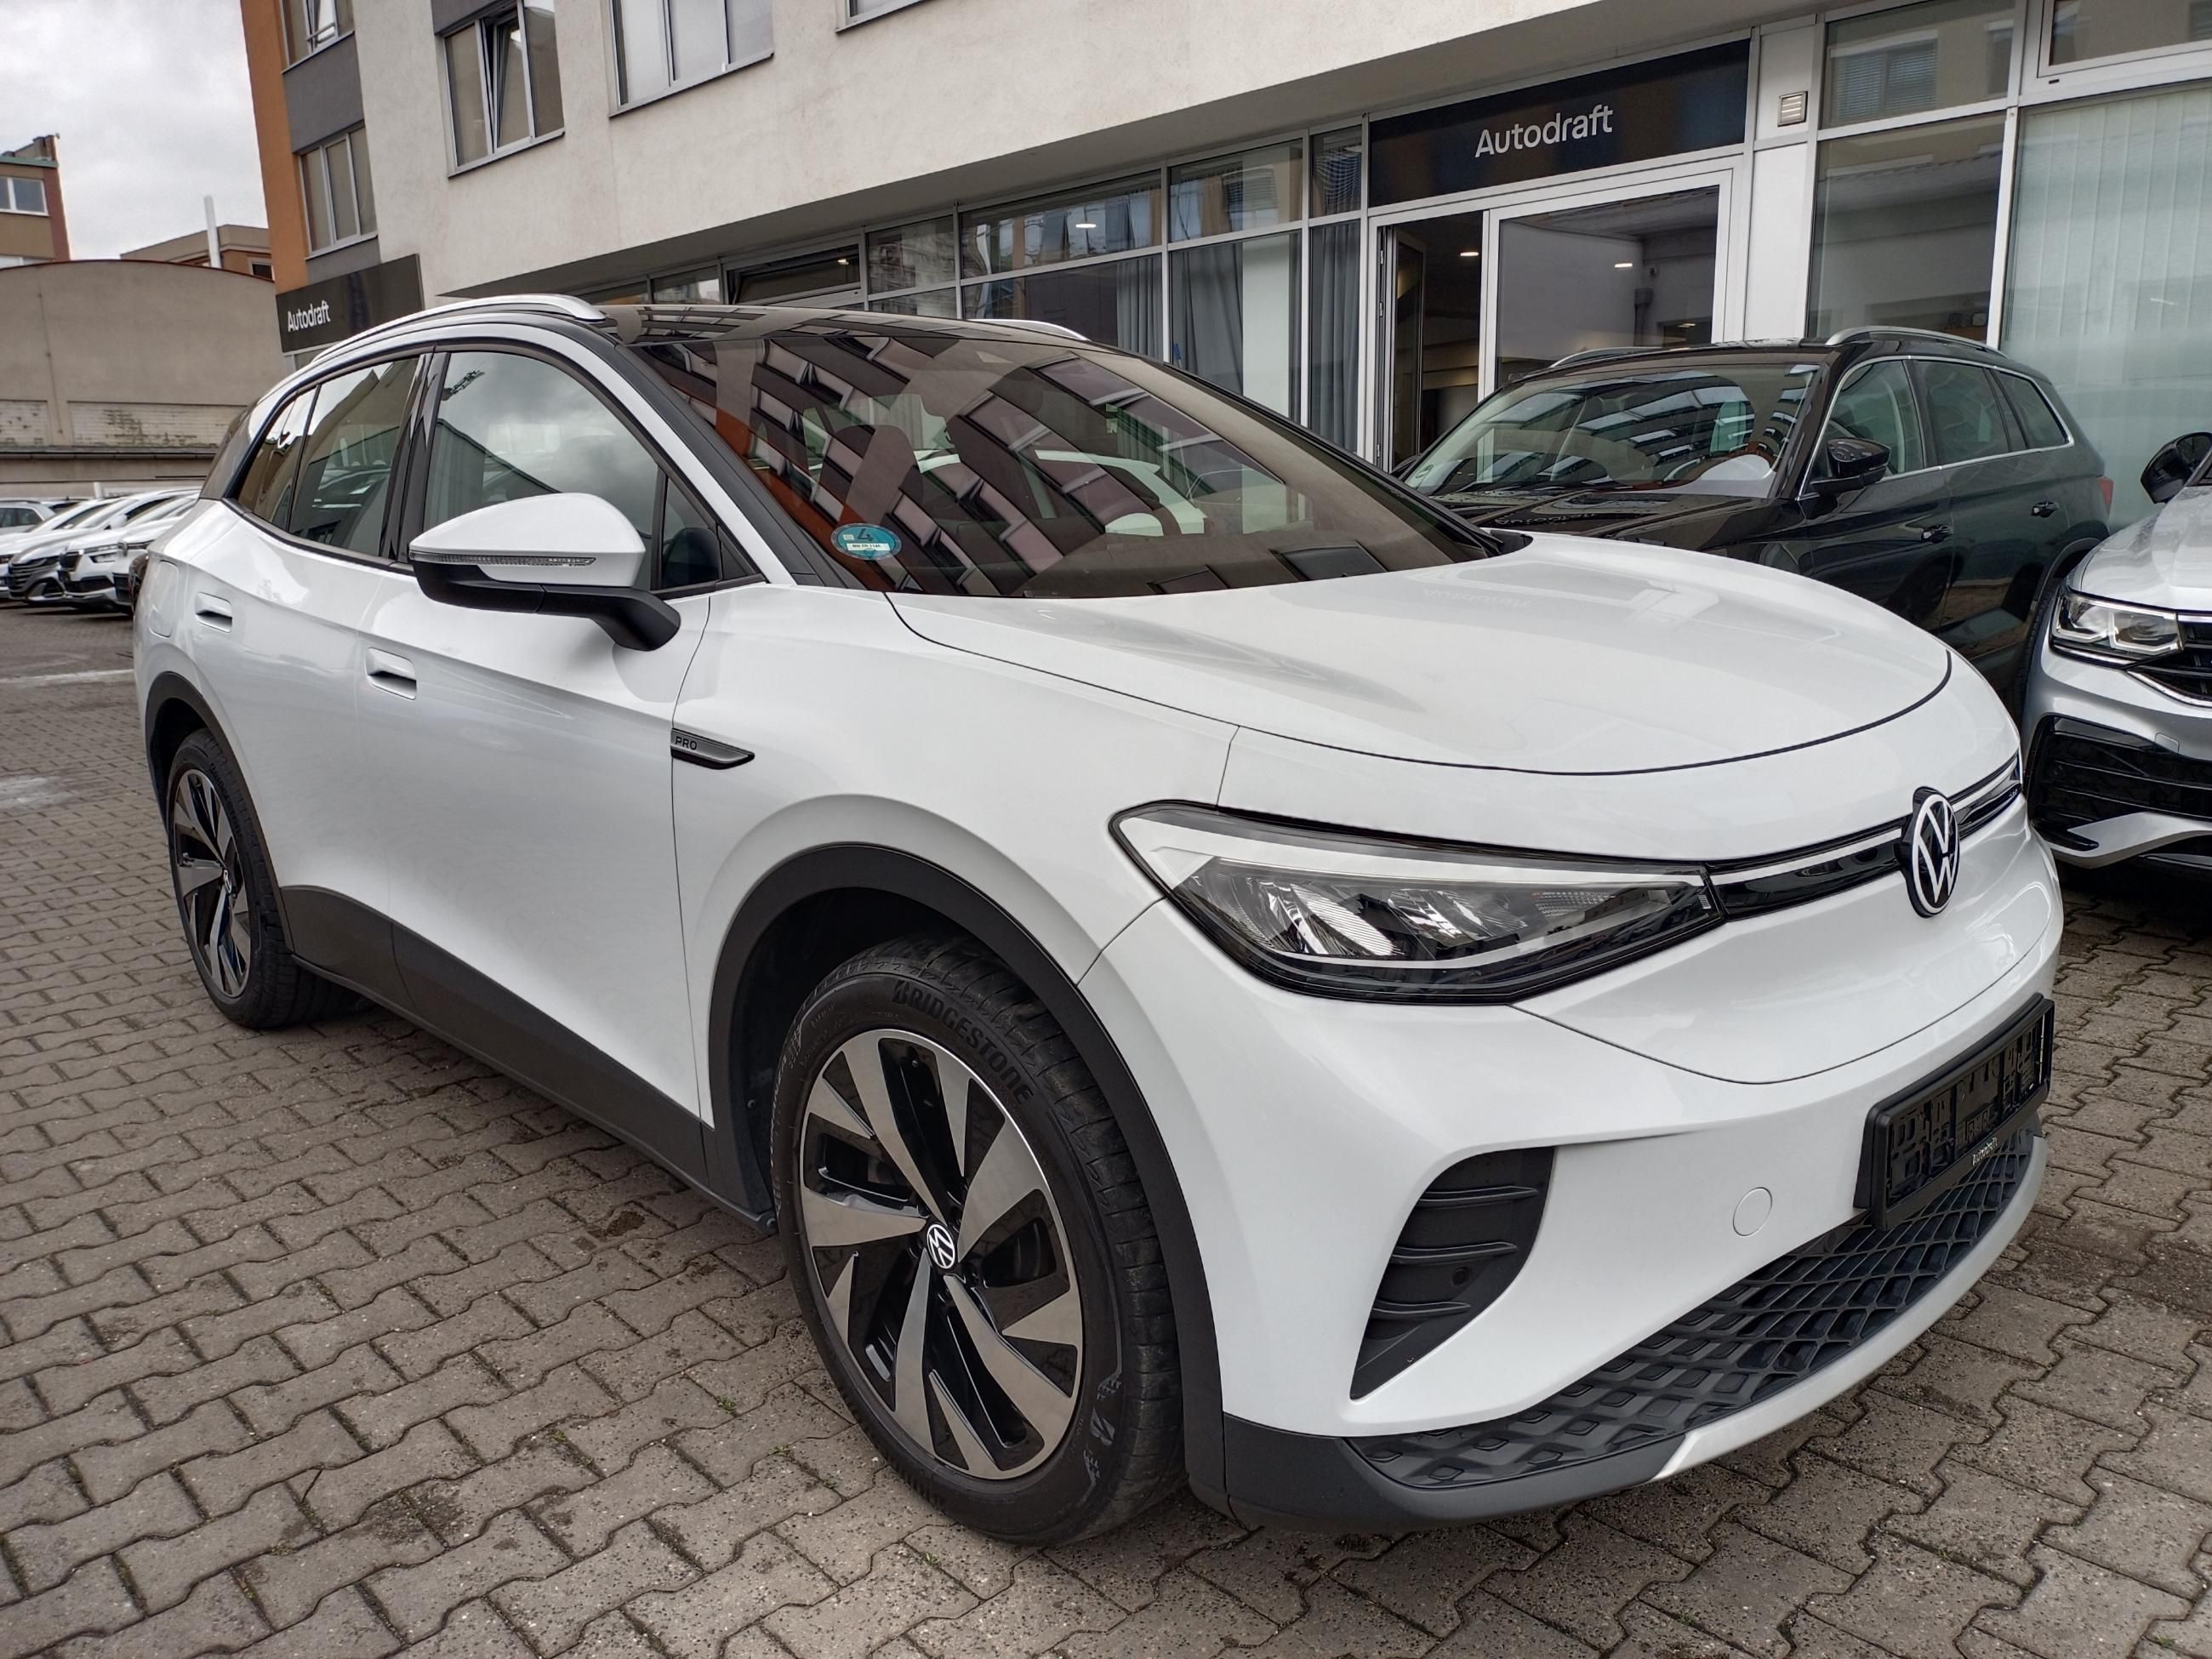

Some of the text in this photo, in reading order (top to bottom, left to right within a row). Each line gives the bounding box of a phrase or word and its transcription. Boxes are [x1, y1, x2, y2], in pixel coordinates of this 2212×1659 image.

[1474, 104, 1614, 158] Autodraft
[287, 299, 331, 333] Autodraft
[675, 736, 698, 750] PRO
[892, 979, 1035, 1105] BRIDGESTONE
